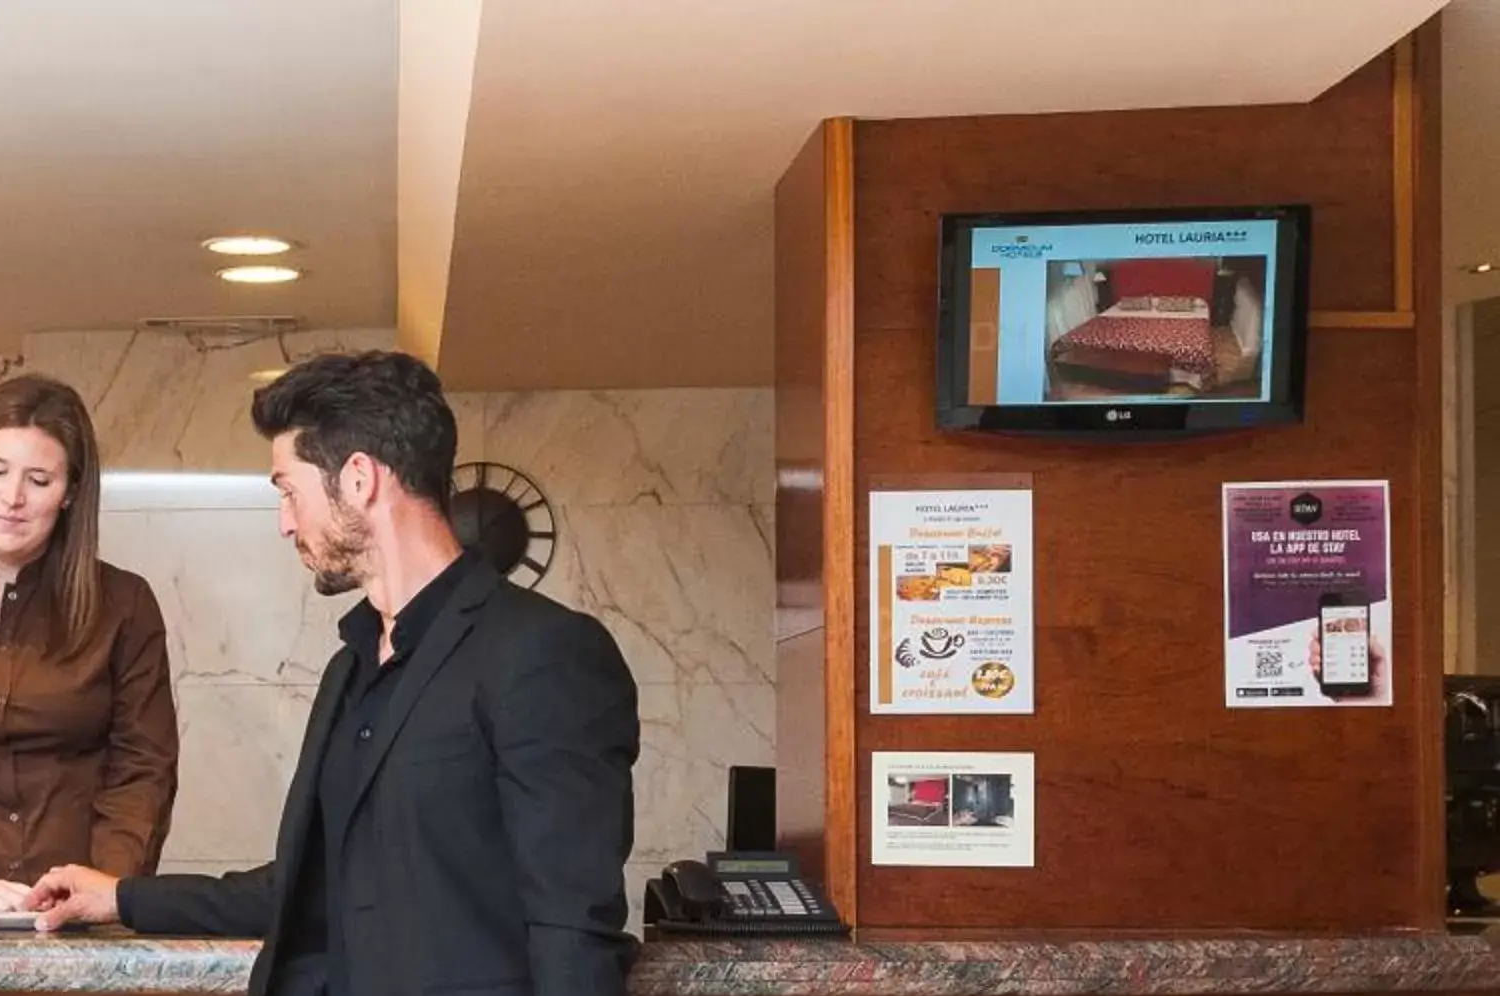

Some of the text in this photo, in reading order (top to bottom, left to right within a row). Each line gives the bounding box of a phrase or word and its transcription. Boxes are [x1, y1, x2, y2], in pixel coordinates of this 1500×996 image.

[1135, 233, 1174, 245] HOTEL
[1251, 529, 1360, 542] USA EN NUESTRO HOTEL
[1270, 542, 1346, 554] LA APP DE STAY
